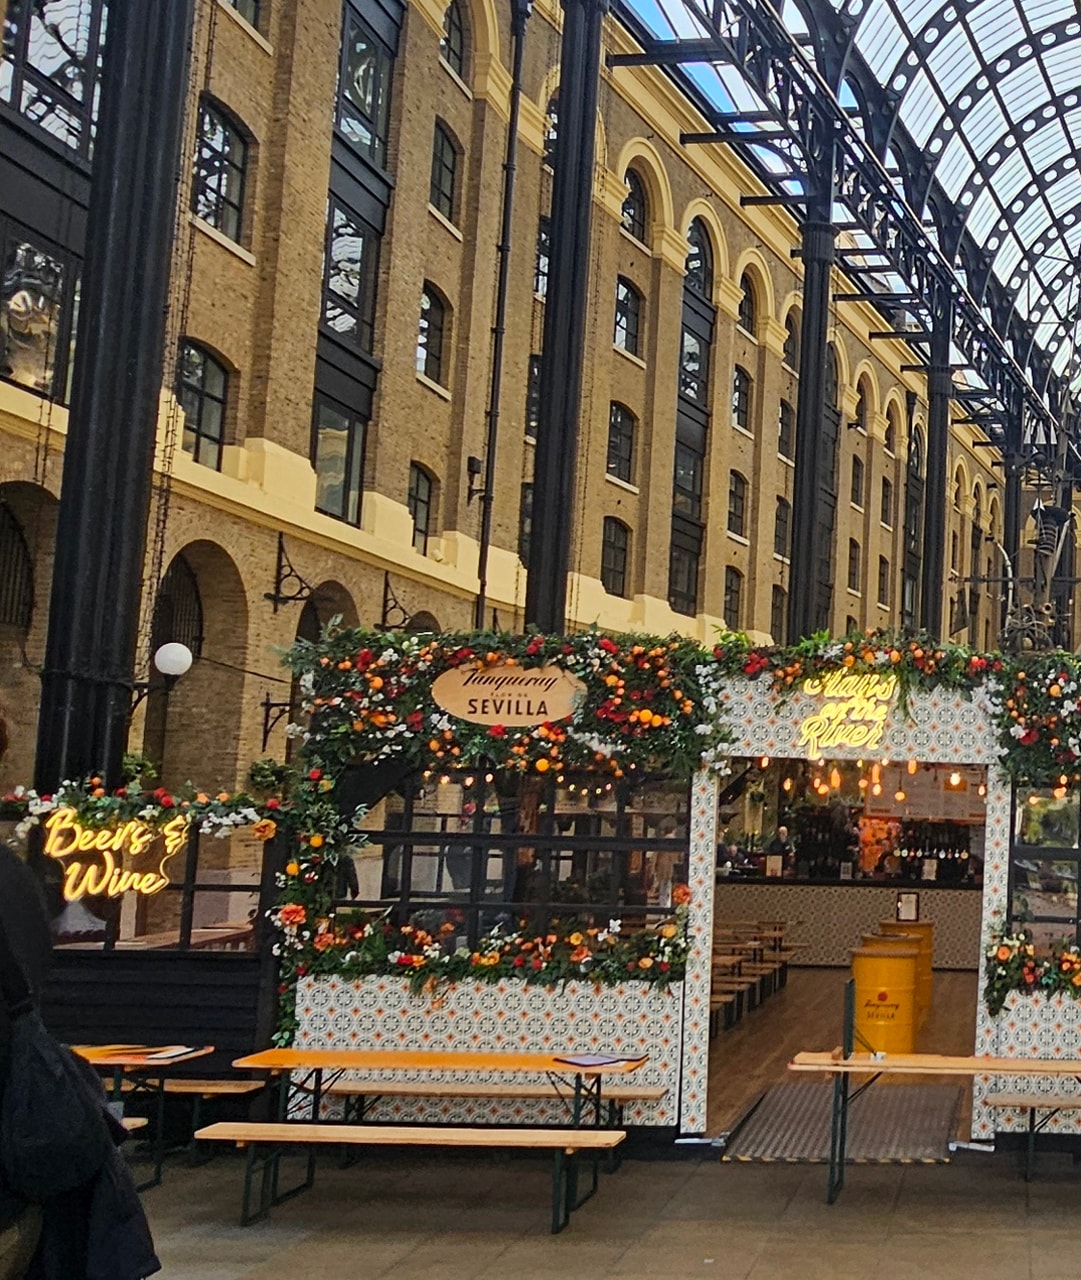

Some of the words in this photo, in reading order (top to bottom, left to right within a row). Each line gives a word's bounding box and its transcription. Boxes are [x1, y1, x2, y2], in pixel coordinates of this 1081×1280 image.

[461, 668, 558, 692] Tanqueray
[467, 698, 548, 716] SEVILLA
[798, 715, 884, 760] River
[43, 807, 152, 858] Beers
[163, 815, 187, 854] &
[64, 851, 167, 902] Wine
